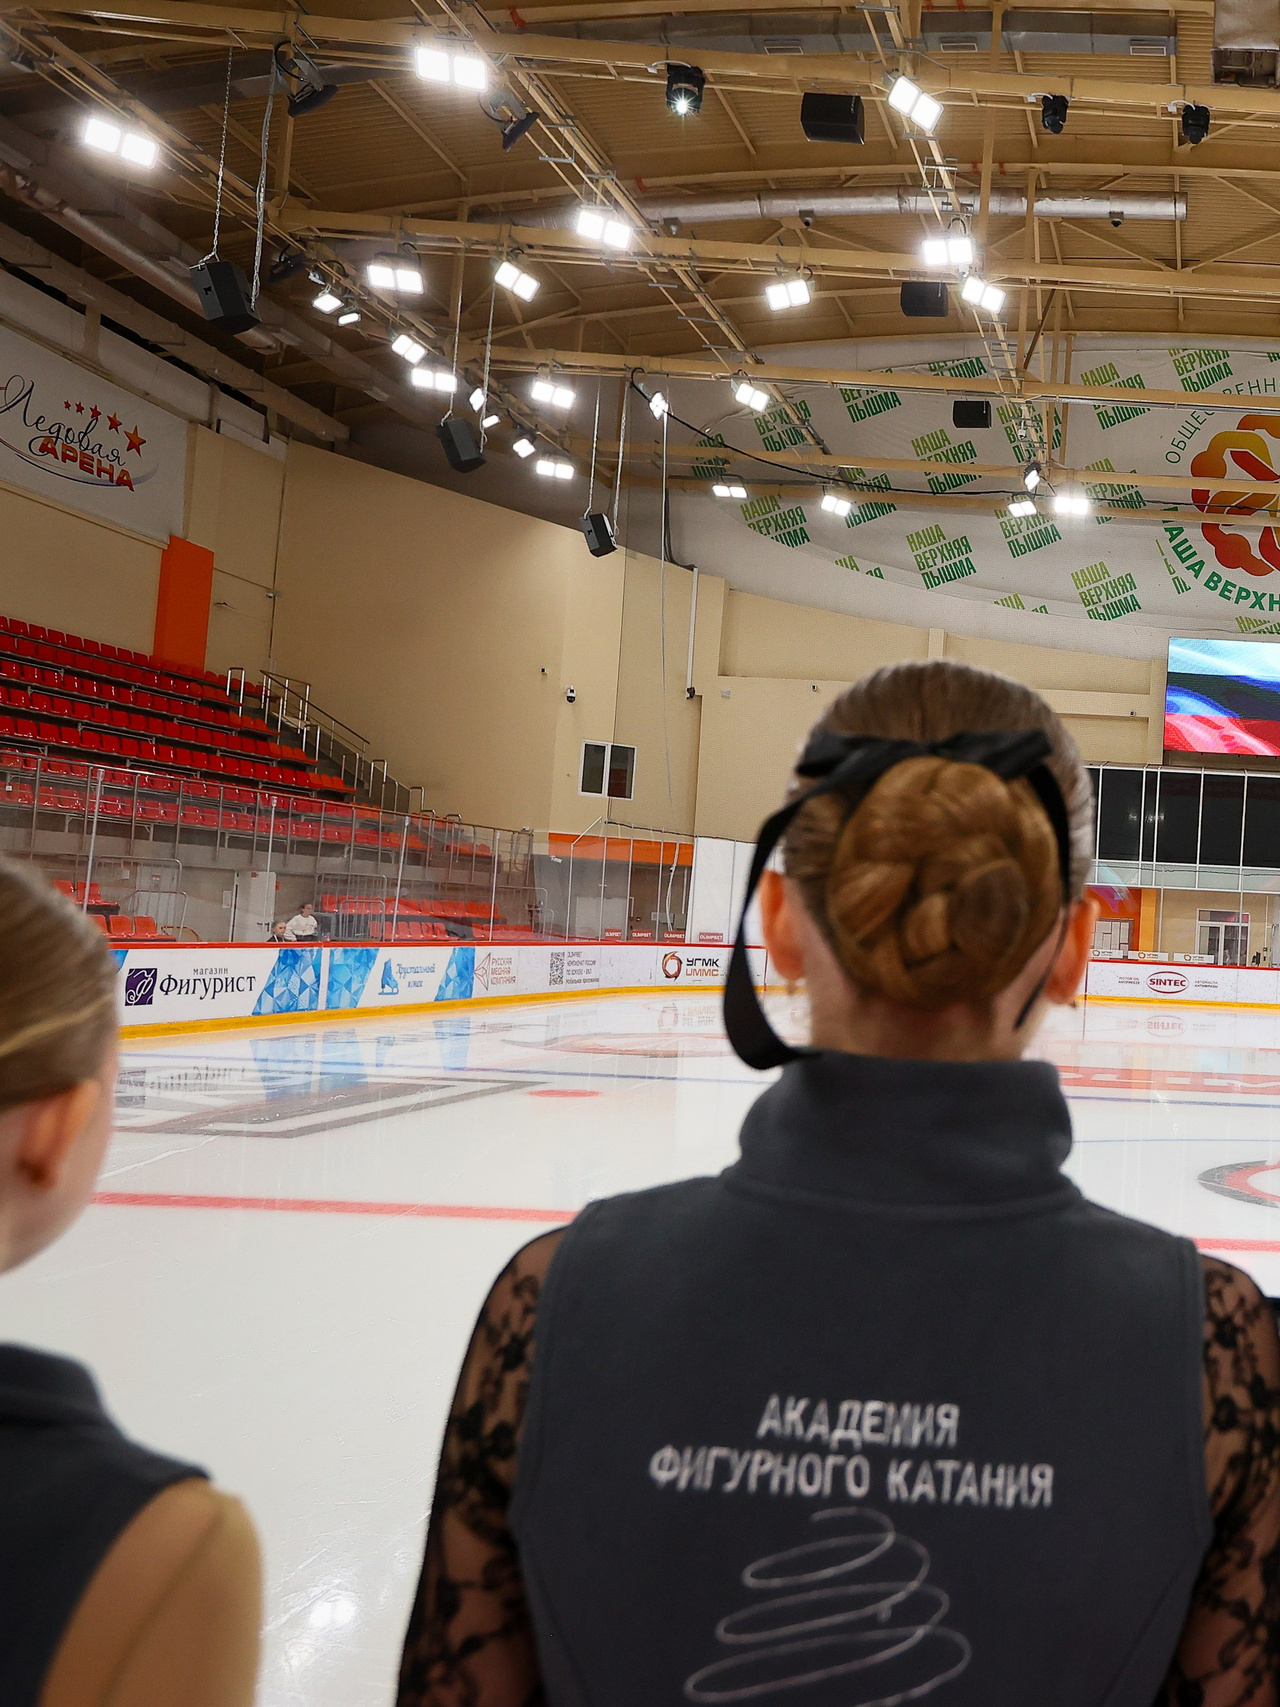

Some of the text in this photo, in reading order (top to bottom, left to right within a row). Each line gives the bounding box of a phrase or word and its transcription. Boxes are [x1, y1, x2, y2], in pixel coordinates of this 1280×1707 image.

[847, 391, 902, 423] ПЫШМА
[911, 429, 951, 457] НАША
[38, 436, 135, 492] АРЕНА
[740, 495, 781, 521] НАША
[905, 523, 946, 552] НАША
[1006, 523, 1062, 558] ПЫШМА
[914, 535, 973, 571] ВЕРХНЯЯ
[921, 556, 977, 590] ПЫШМА
[1071, 561, 1111, 590] НАША
[1079, 572, 1137, 608] ВЕРХНЯЯ
[193, 967, 228, 976] магазин
[685, 968, 719, 977] UMMC
[686, 957, 720, 967] УГМК
[159, 974, 256, 1000] Фигурист
[1149, 978, 1187, 987] SINTEC
[756, 1394, 960, 1451] АКАДЕМИЯ
[648, 1444, 1055, 1509] ФИГУРНОГО КАТАНИЯ
